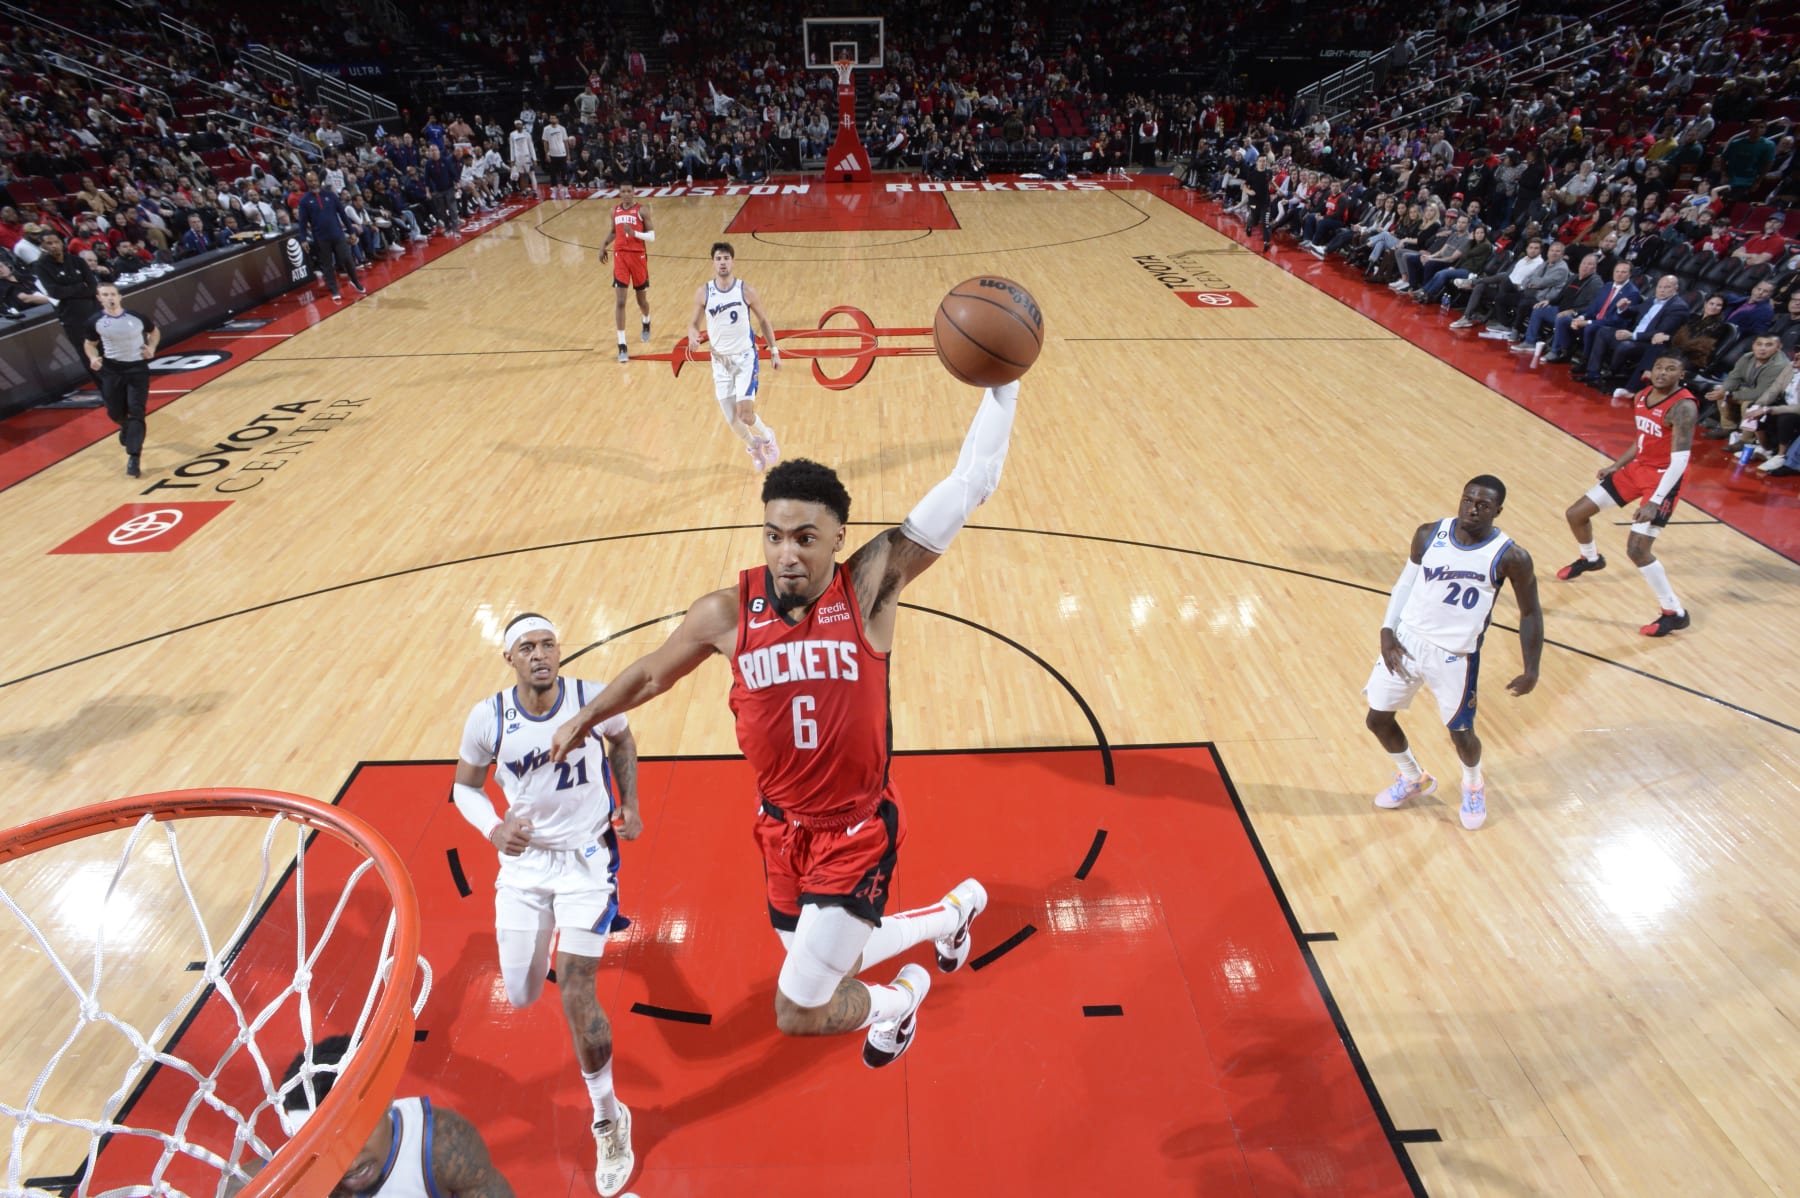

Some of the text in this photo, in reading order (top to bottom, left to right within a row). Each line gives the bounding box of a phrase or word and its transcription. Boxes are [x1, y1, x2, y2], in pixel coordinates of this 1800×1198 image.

[348, 66, 381, 76] ULTRA
[590, 184, 810, 199] HOUSTON
[885, 182, 1105, 193] ROCKETS
[291, 264, 308, 282] AT&T
[1131, 254, 1195, 289] TOYOTA
[729, 310, 739, 325] 9
[139, 400, 323, 496] TOYOTA
[215, 398, 371, 493] CENTER
[1442, 582, 1480, 609] 20
[752, 599, 764, 612] 6
[818, 601, 847, 615] credit
[817, 612, 851, 625] karma
[738, 640, 859, 690] ROCKETS
[792, 695, 818, 749] 6
[554, 755, 590, 791] 21
